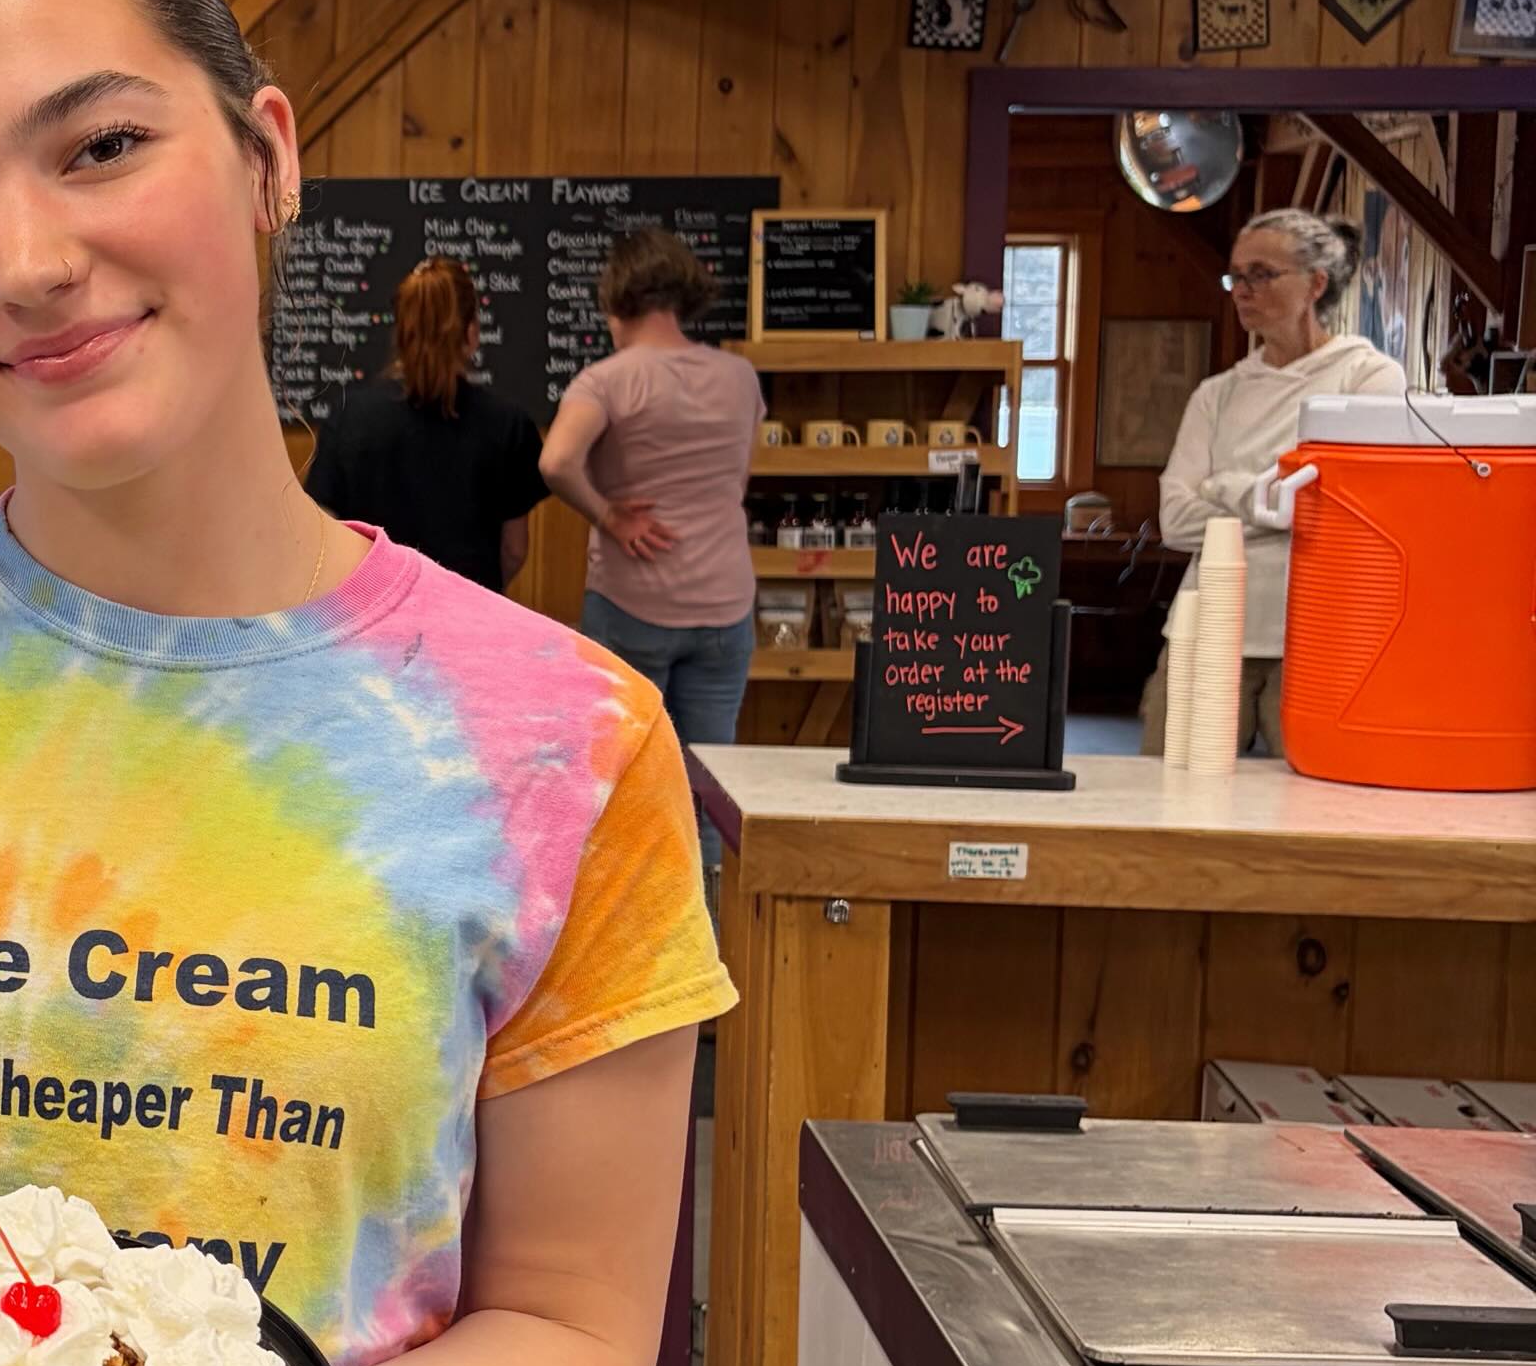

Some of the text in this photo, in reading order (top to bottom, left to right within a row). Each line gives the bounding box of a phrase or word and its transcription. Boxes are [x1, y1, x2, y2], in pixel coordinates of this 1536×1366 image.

[409, 179, 446, 204] ICE
[460, 177, 531, 203] CREAM
[891, 531, 1008, 571] We are
[885, 582, 999, 623] happy to
[883, 626, 1011, 659] take your
[885, 659, 1032, 686] order at the
[905, 688, 990, 722] register
[68, 929, 377, 1030] Cream
[210, 1074, 346, 1150] Than
